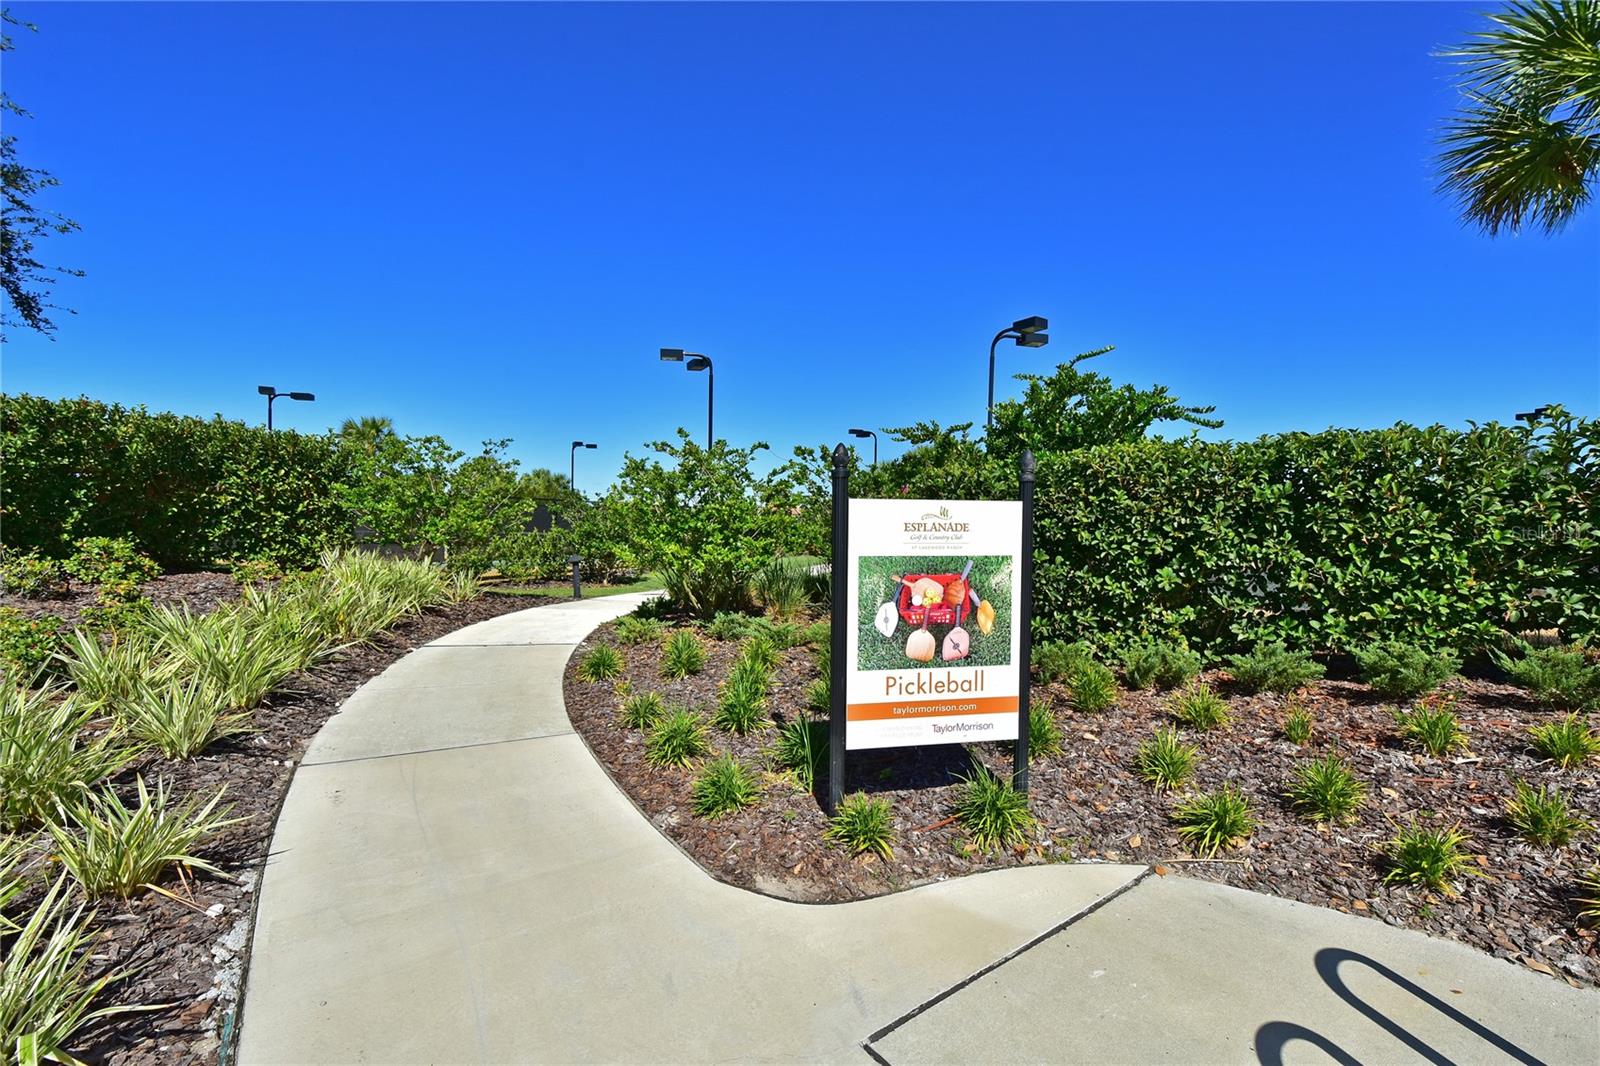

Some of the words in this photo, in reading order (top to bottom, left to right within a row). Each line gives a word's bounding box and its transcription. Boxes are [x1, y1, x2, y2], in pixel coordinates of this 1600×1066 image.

[904, 522, 970, 532] ESPLANADE
[929, 534, 950, 542] Country
[886, 670, 984, 696] Pickleball
[893, 703, 977, 715] taylormorrison.com
[932, 722, 994, 735] TaylorMorrison
